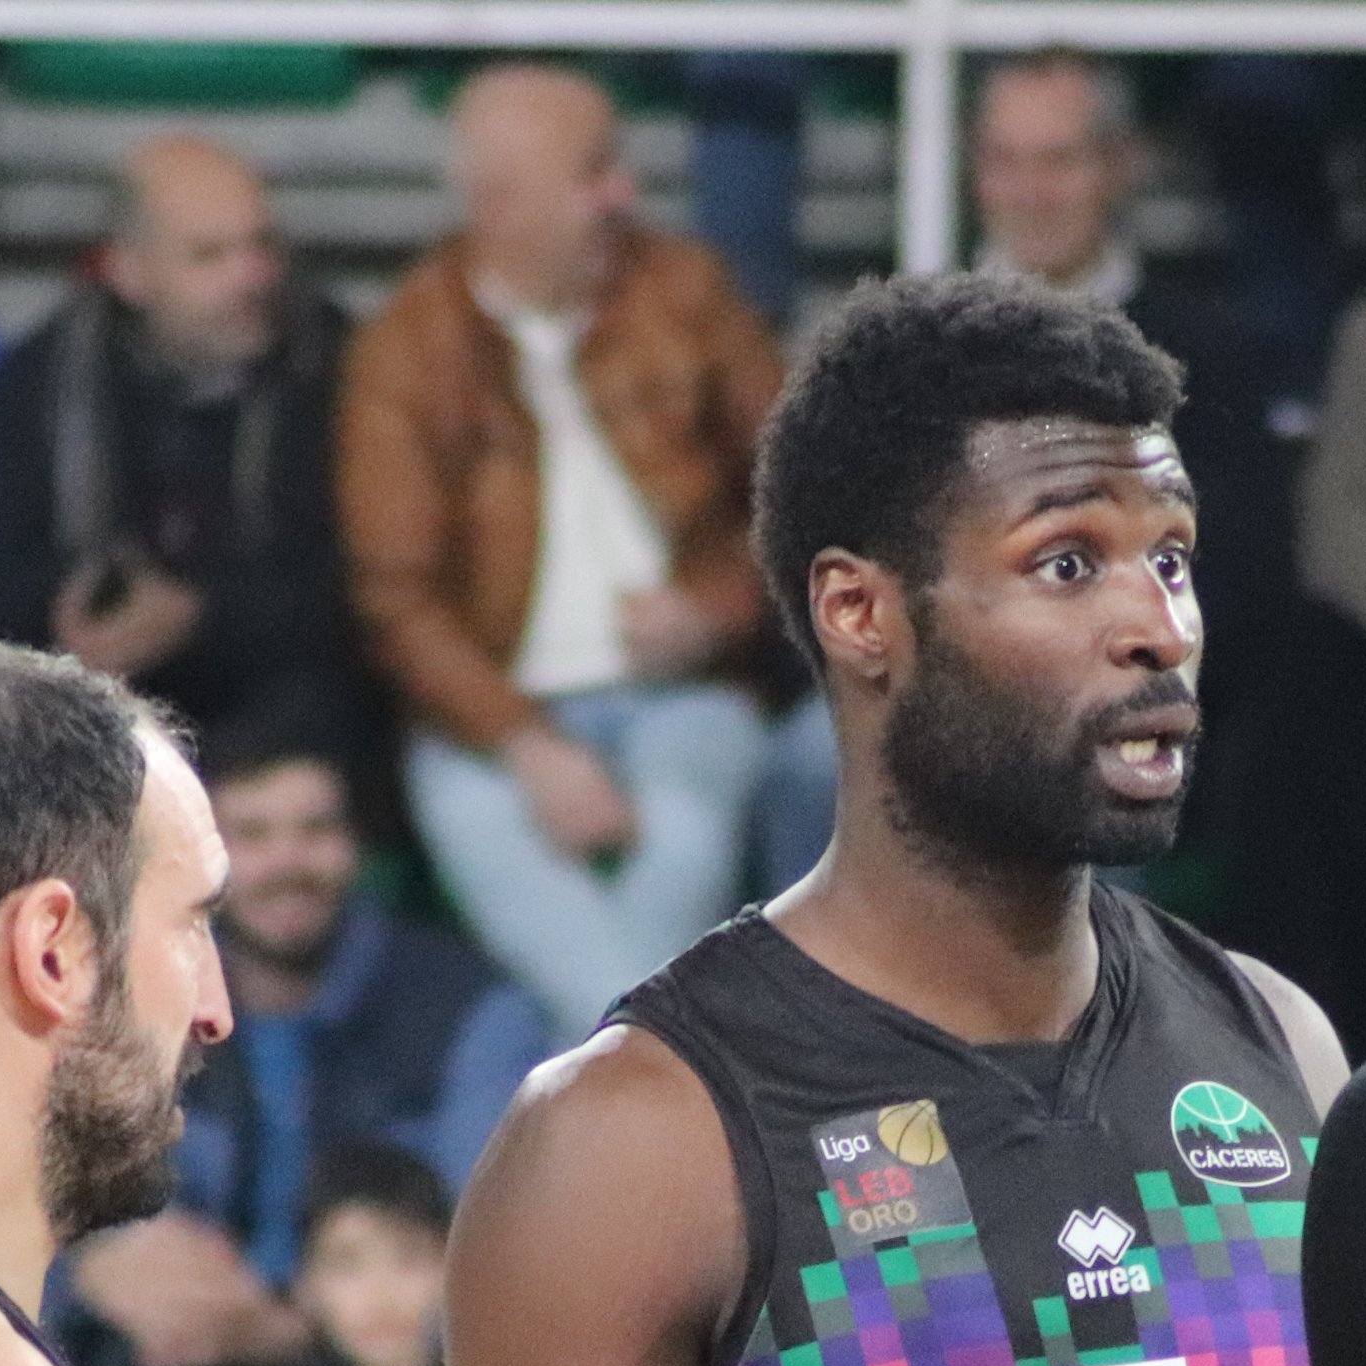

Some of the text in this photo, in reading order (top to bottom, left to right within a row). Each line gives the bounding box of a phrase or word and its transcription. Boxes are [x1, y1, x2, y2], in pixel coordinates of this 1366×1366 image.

[819, 1132, 872, 1163] Liga
[835, 1166, 914, 1209] LEB
[847, 1198, 918, 1234] ORO
[1066, 1263, 1151, 1300] errea
